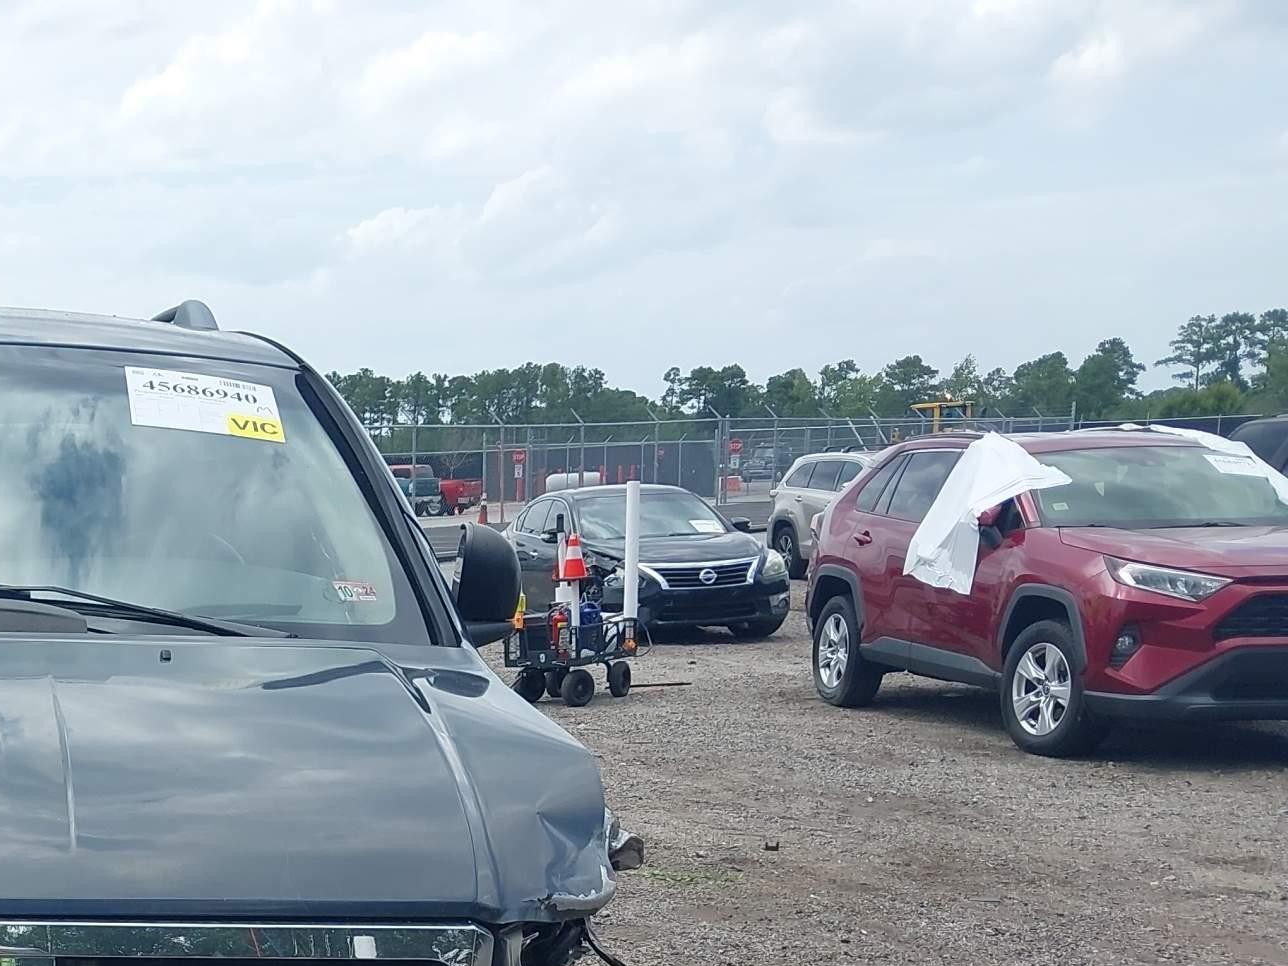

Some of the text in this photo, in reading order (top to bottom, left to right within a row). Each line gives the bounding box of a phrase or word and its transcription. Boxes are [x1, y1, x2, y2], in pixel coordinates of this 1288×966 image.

[142, 380, 258, 404] 45686940
[230, 417, 279, 435] VIC
[337, 585, 353, 598] 10
